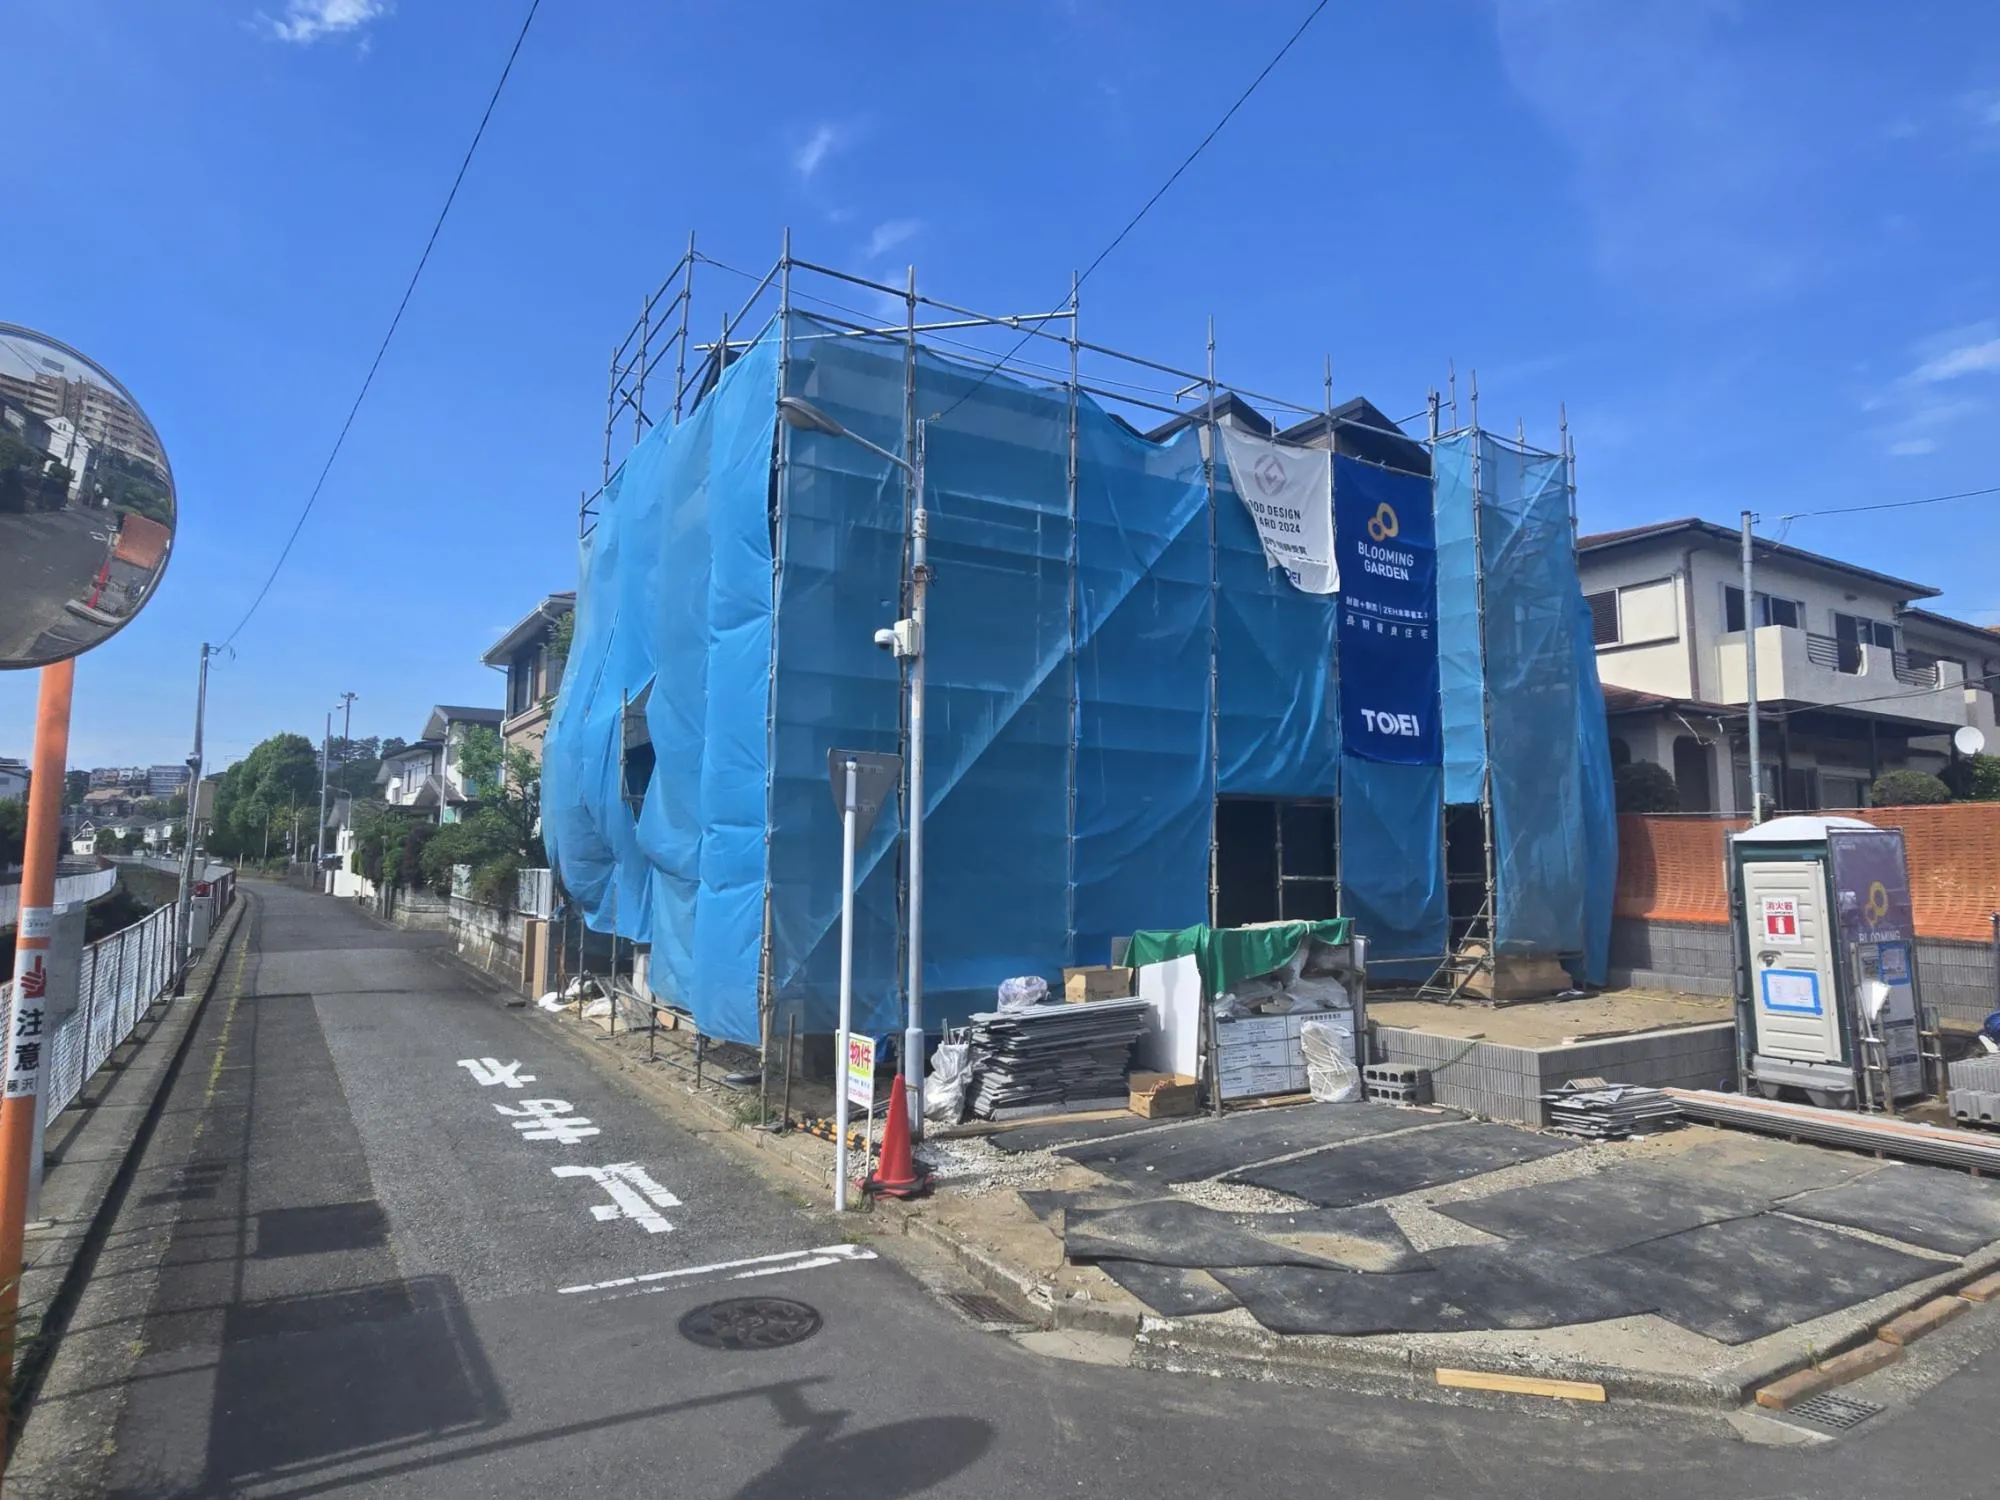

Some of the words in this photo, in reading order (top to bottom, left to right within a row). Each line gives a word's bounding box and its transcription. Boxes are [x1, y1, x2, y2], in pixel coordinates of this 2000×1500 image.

[1267, 505, 1301, 520] DESIGN
[1279, 521, 1301, 534] 2024
[1358, 541, 1414, 567] BLOOMING
[1364, 559, 1409, 581] GARDEN
[1361, 708, 1420, 737] TOEI
[1766, 901, 1793, 911] 消火器
[14, 1007, 44, 1072] 注意
[849, 1040, 872, 1070] 物件
[457, 1057, 683, 1234] 止まれ
